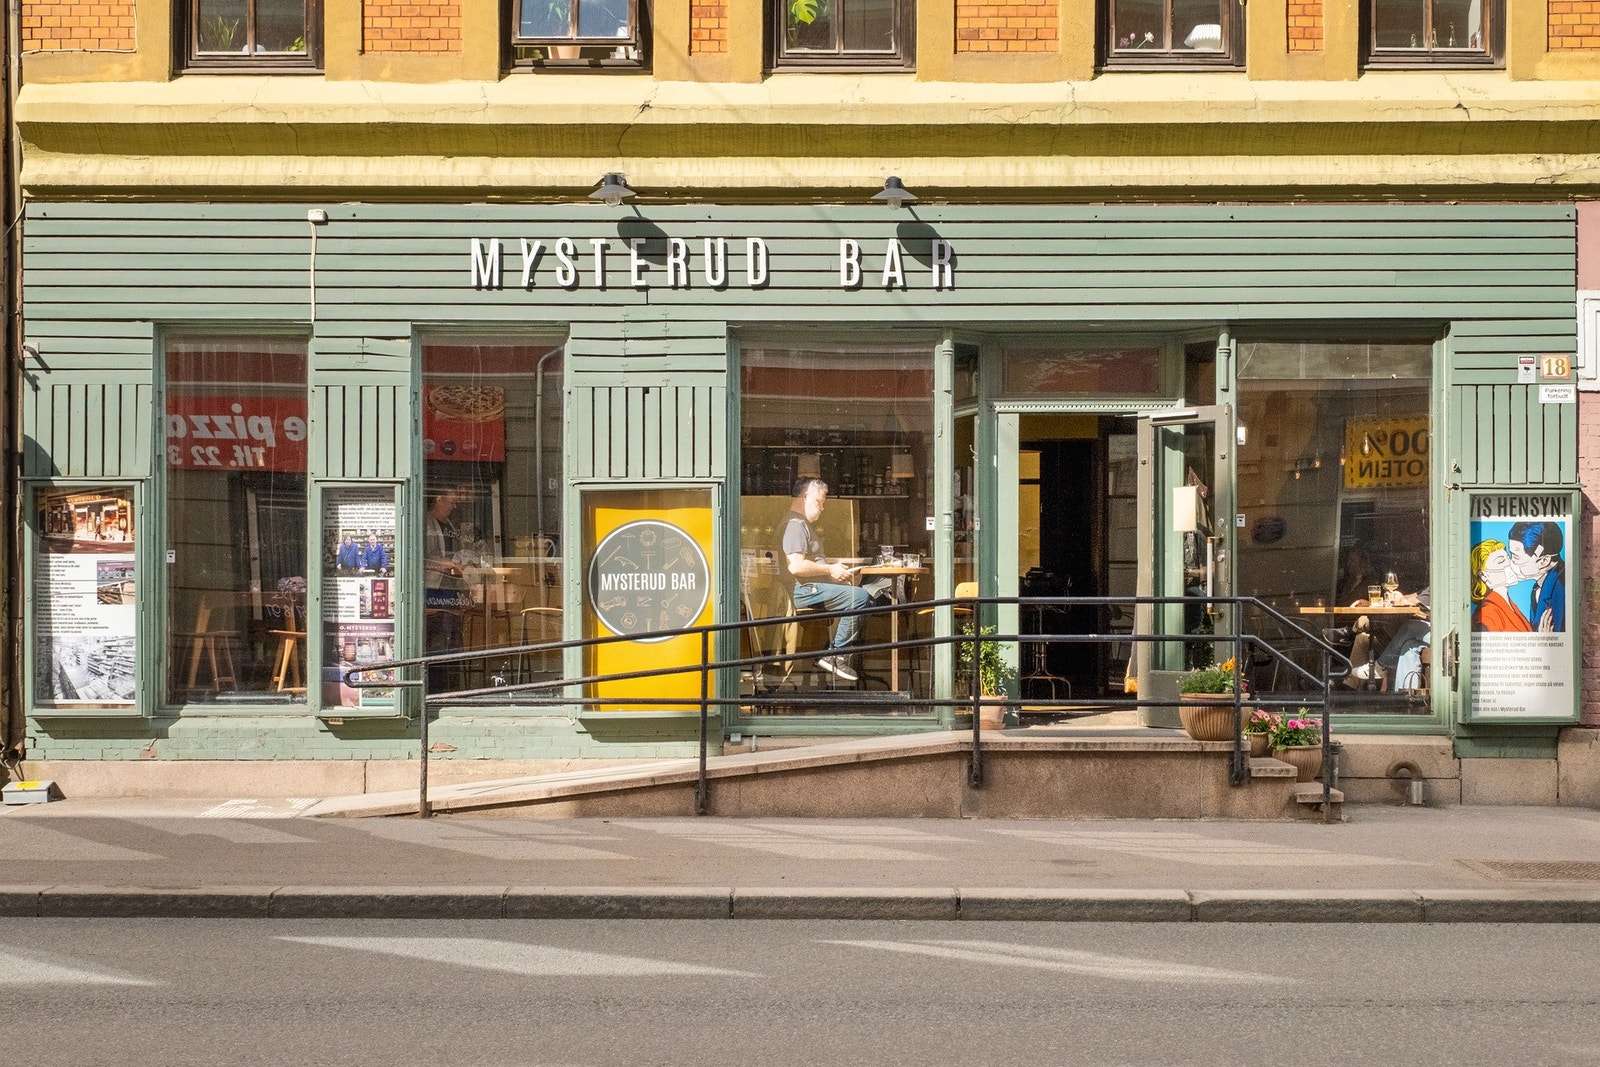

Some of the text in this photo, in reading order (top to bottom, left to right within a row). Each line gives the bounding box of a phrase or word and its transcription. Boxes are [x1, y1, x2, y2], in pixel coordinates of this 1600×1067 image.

[470, 237, 952, 287] MYSTERUD BAR
[1545, 358, 1566, 376] 18
[1498, 496, 1566, 518] HENSYN!
[602, 572, 696, 590] MYSTERUD BAR
